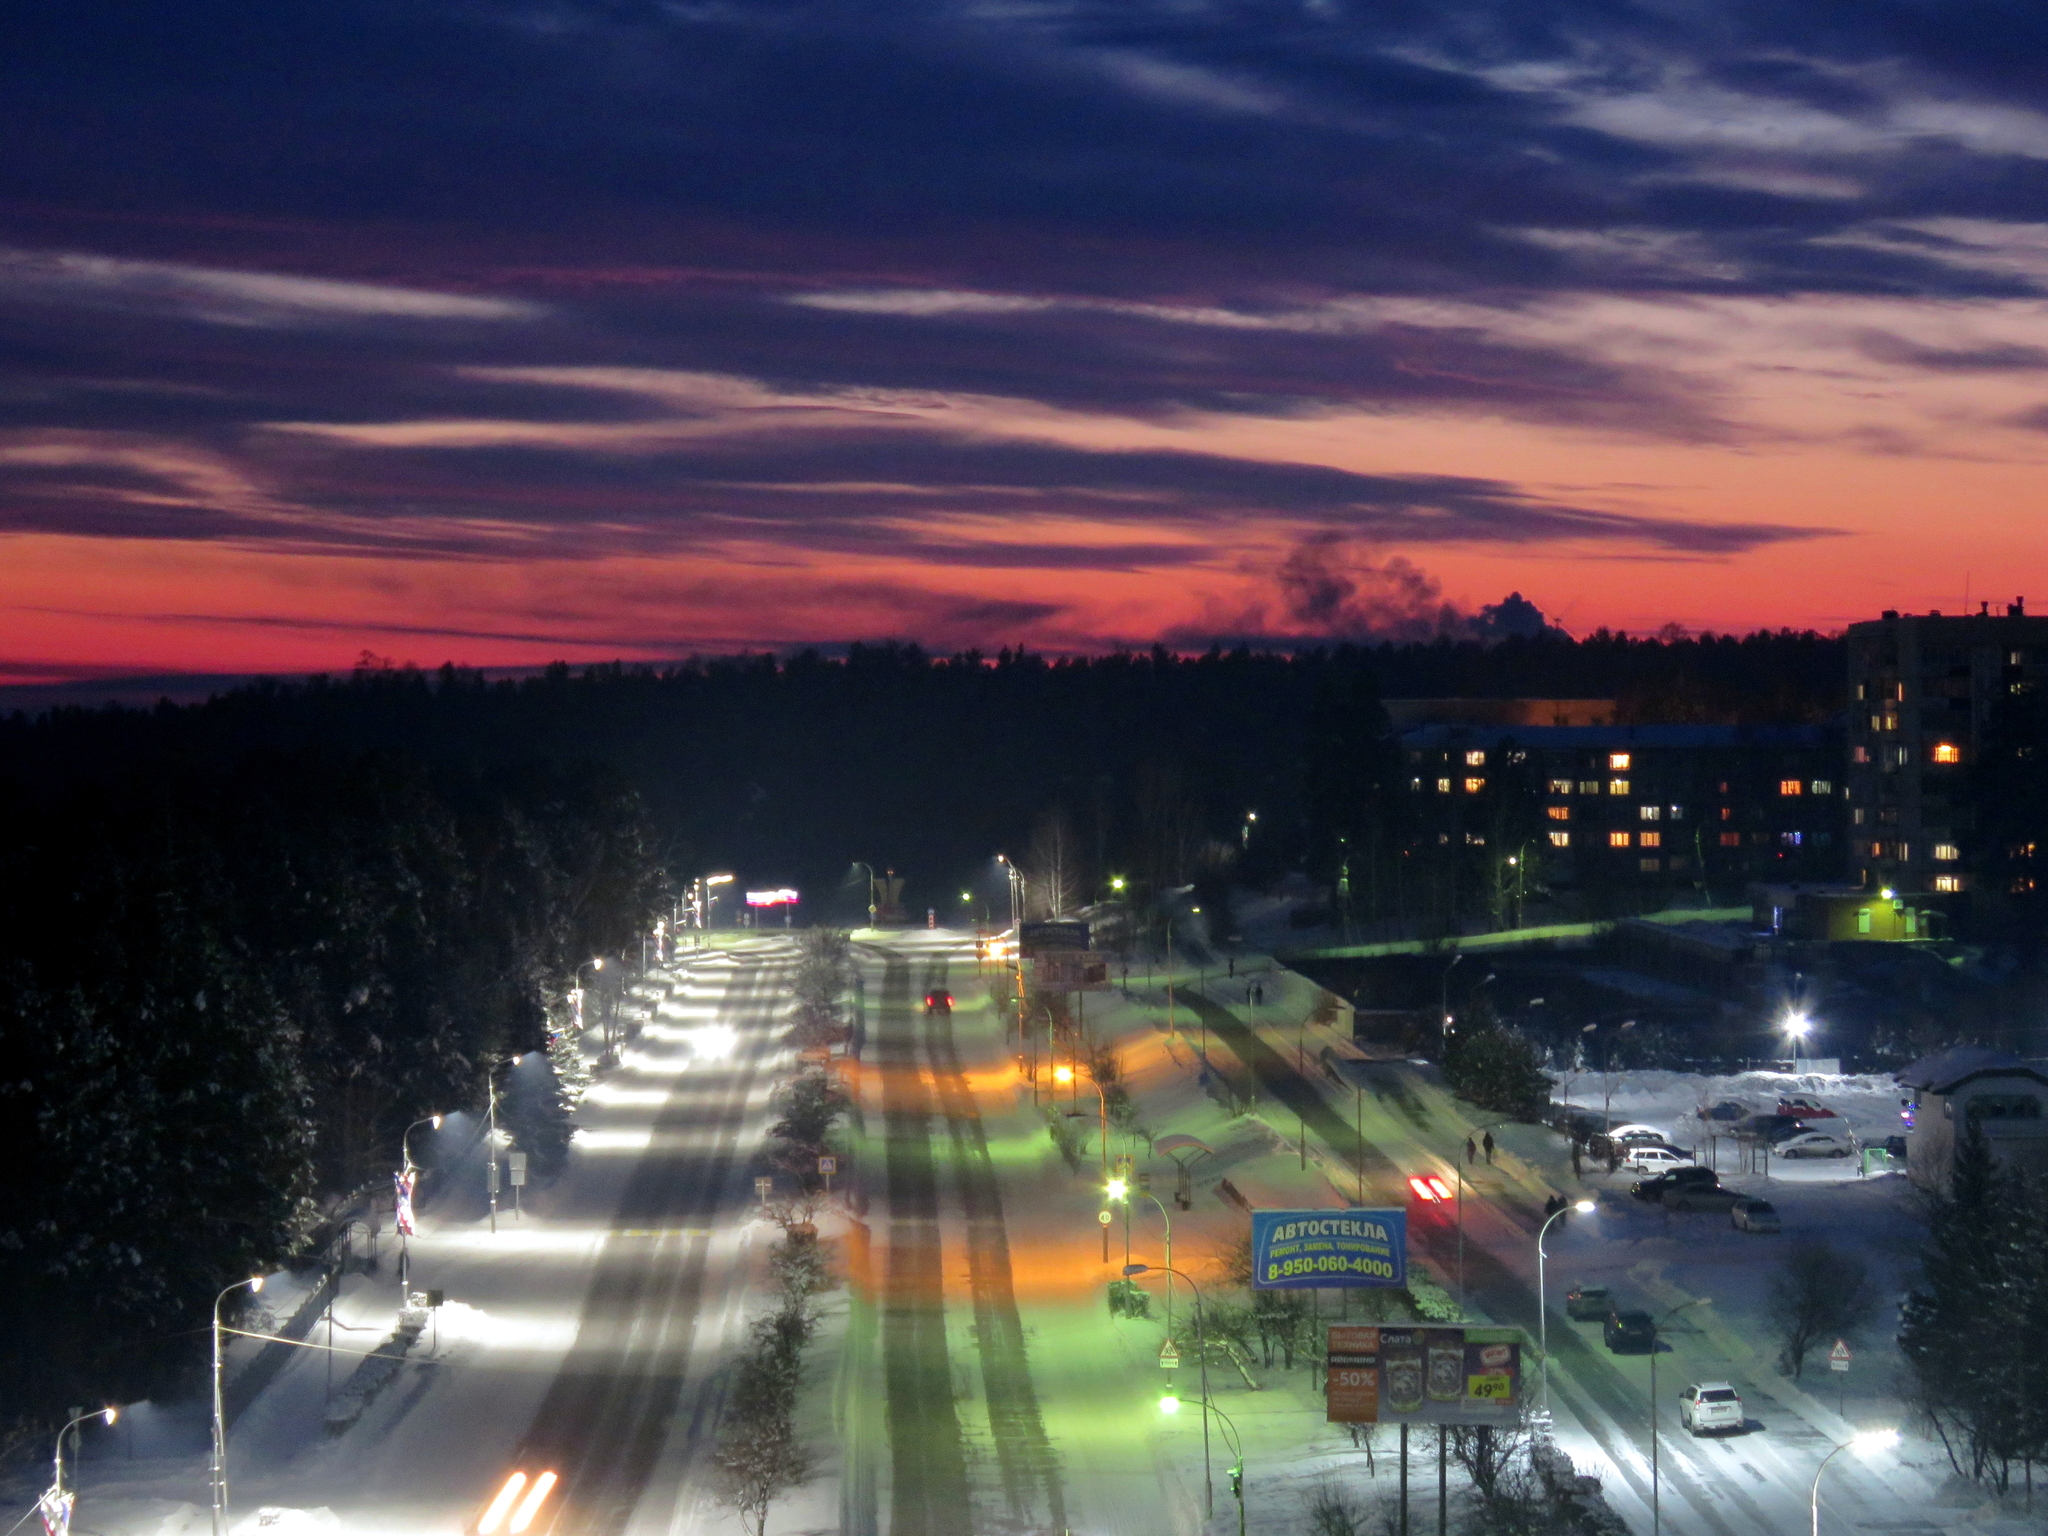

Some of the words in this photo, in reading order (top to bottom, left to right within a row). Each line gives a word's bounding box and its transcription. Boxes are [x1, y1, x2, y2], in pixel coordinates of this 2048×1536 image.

[1272, 1219, 1388, 1242] АВТОСТЕКЛА
[1270, 1246, 1302, 1258] РЕМОНТ,
[1304, 1242, 1334, 1251] ЗАМЕНА,
[1336, 1242, 1390, 1257] ТОНИРОВАНИЕ
[1268, 1256, 1393, 1279] 8-950-060-4000
[1331, 1341, 1374, 1349] ТЕХНИКА
[1380, 1333, 1412, 1345] Слата
[1333, 1371, 1375, 1387] -50%
